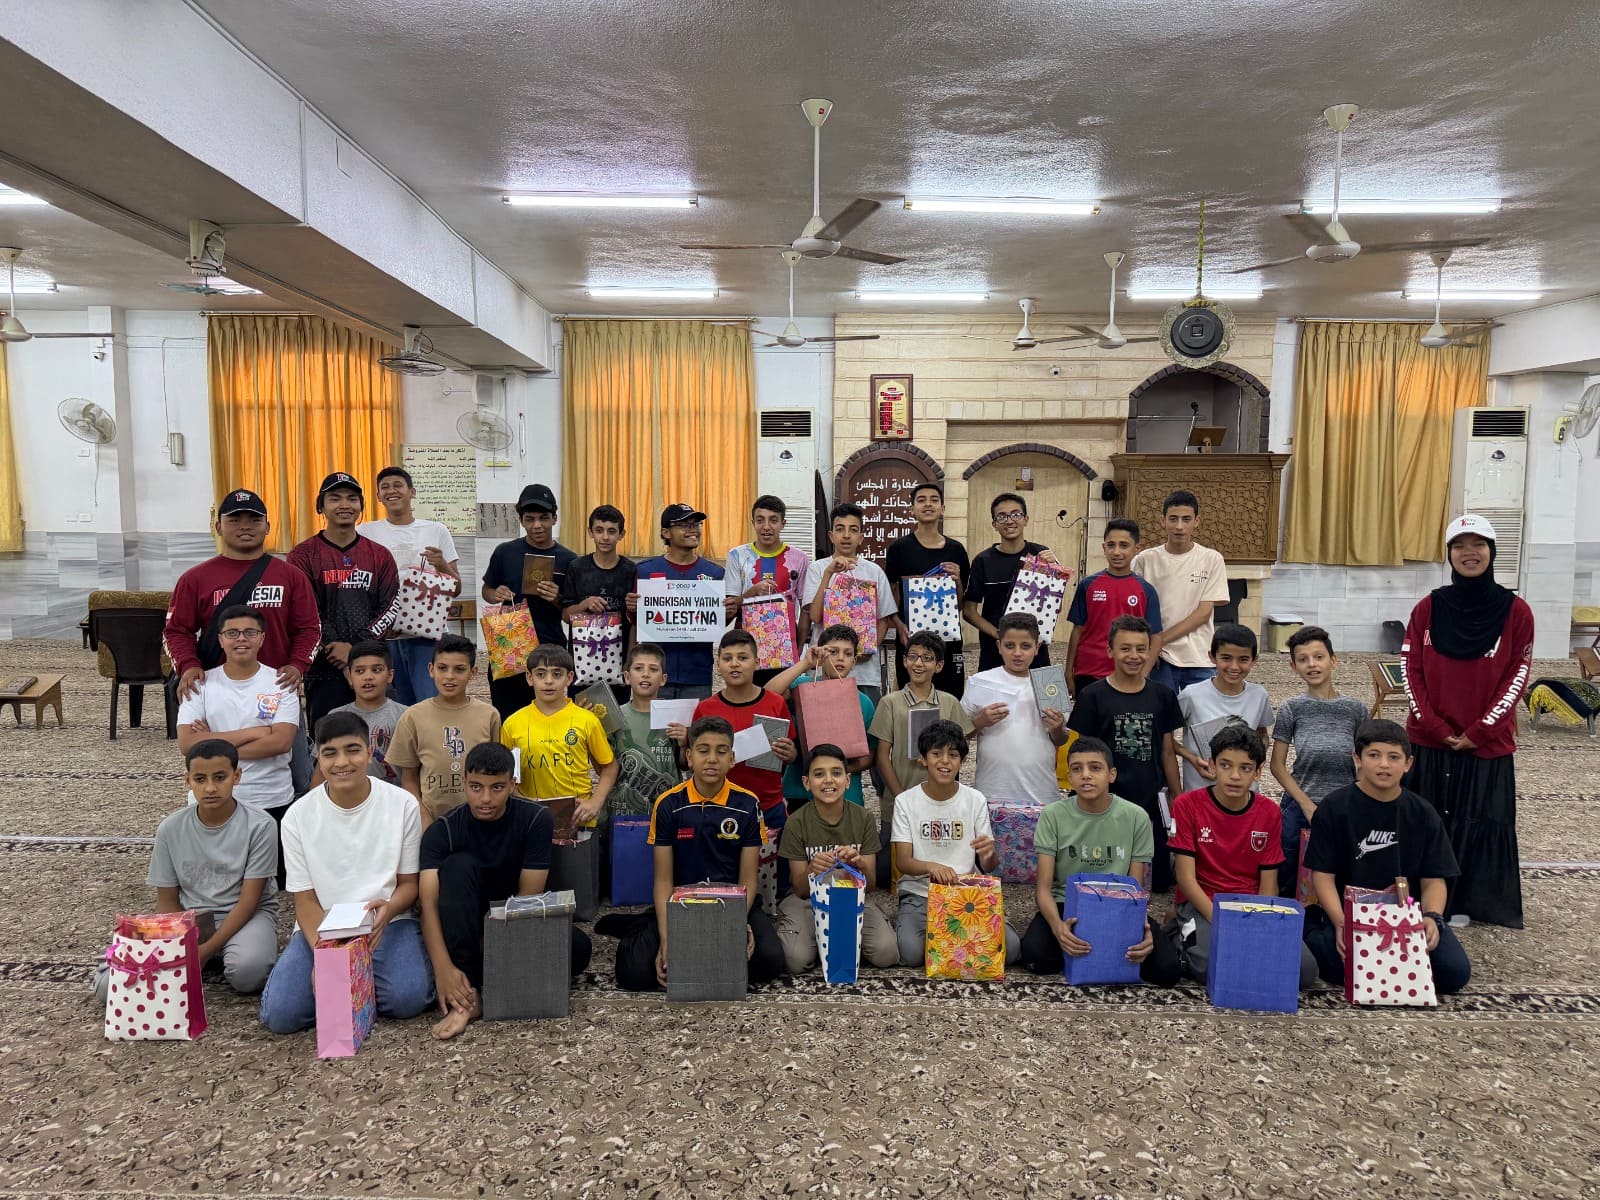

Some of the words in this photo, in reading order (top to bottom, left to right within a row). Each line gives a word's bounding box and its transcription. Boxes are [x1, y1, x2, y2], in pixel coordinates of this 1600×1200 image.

[856, 479, 888, 491] المجلس
[891, 479, 919, 491] كفارة
[644, 596, 691, 607] BINGKISAN
[694, 596, 720, 607] YATIM
[1482, 664, 1529, 726] INDONESIA
[1367, 830, 1397, 843] NIKE
[1068, 844, 1125, 860] BEGIN
